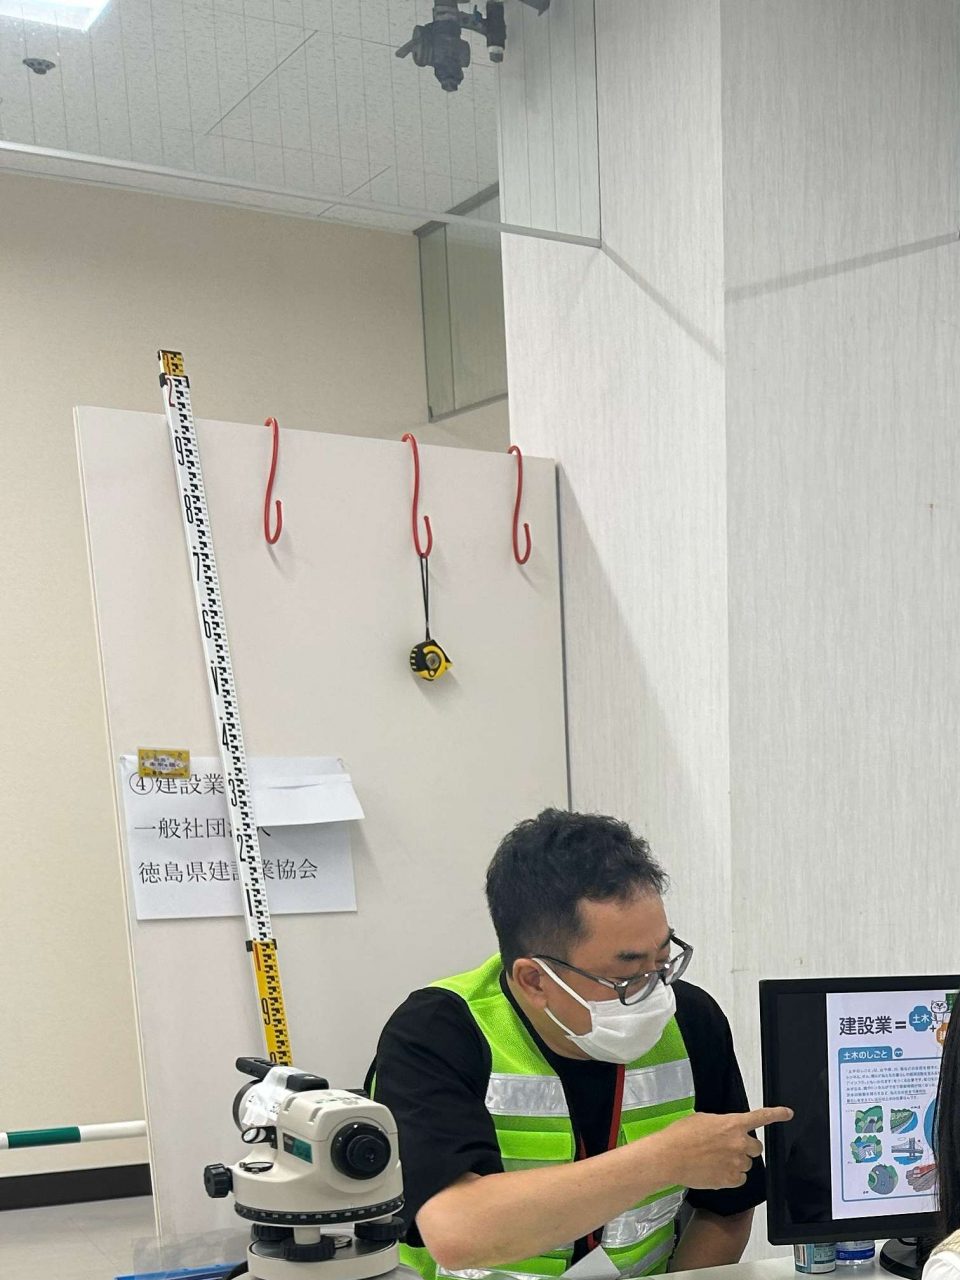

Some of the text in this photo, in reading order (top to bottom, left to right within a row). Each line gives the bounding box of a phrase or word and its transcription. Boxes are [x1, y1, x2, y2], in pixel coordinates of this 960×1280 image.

[175, 436, 185, 466] 9
[184, 494, 194, 524] 8
[193, 551, 201, 581] 7
[202, 609, 211, 639] 6
[228, 780, 238, 807] 3
[237, 834, 247, 862] 2
[261, 998, 271, 1026] 9
[912, 1013, 930, 1024] 土木
[843, 1050, 888, 1060] 土木のしごと
